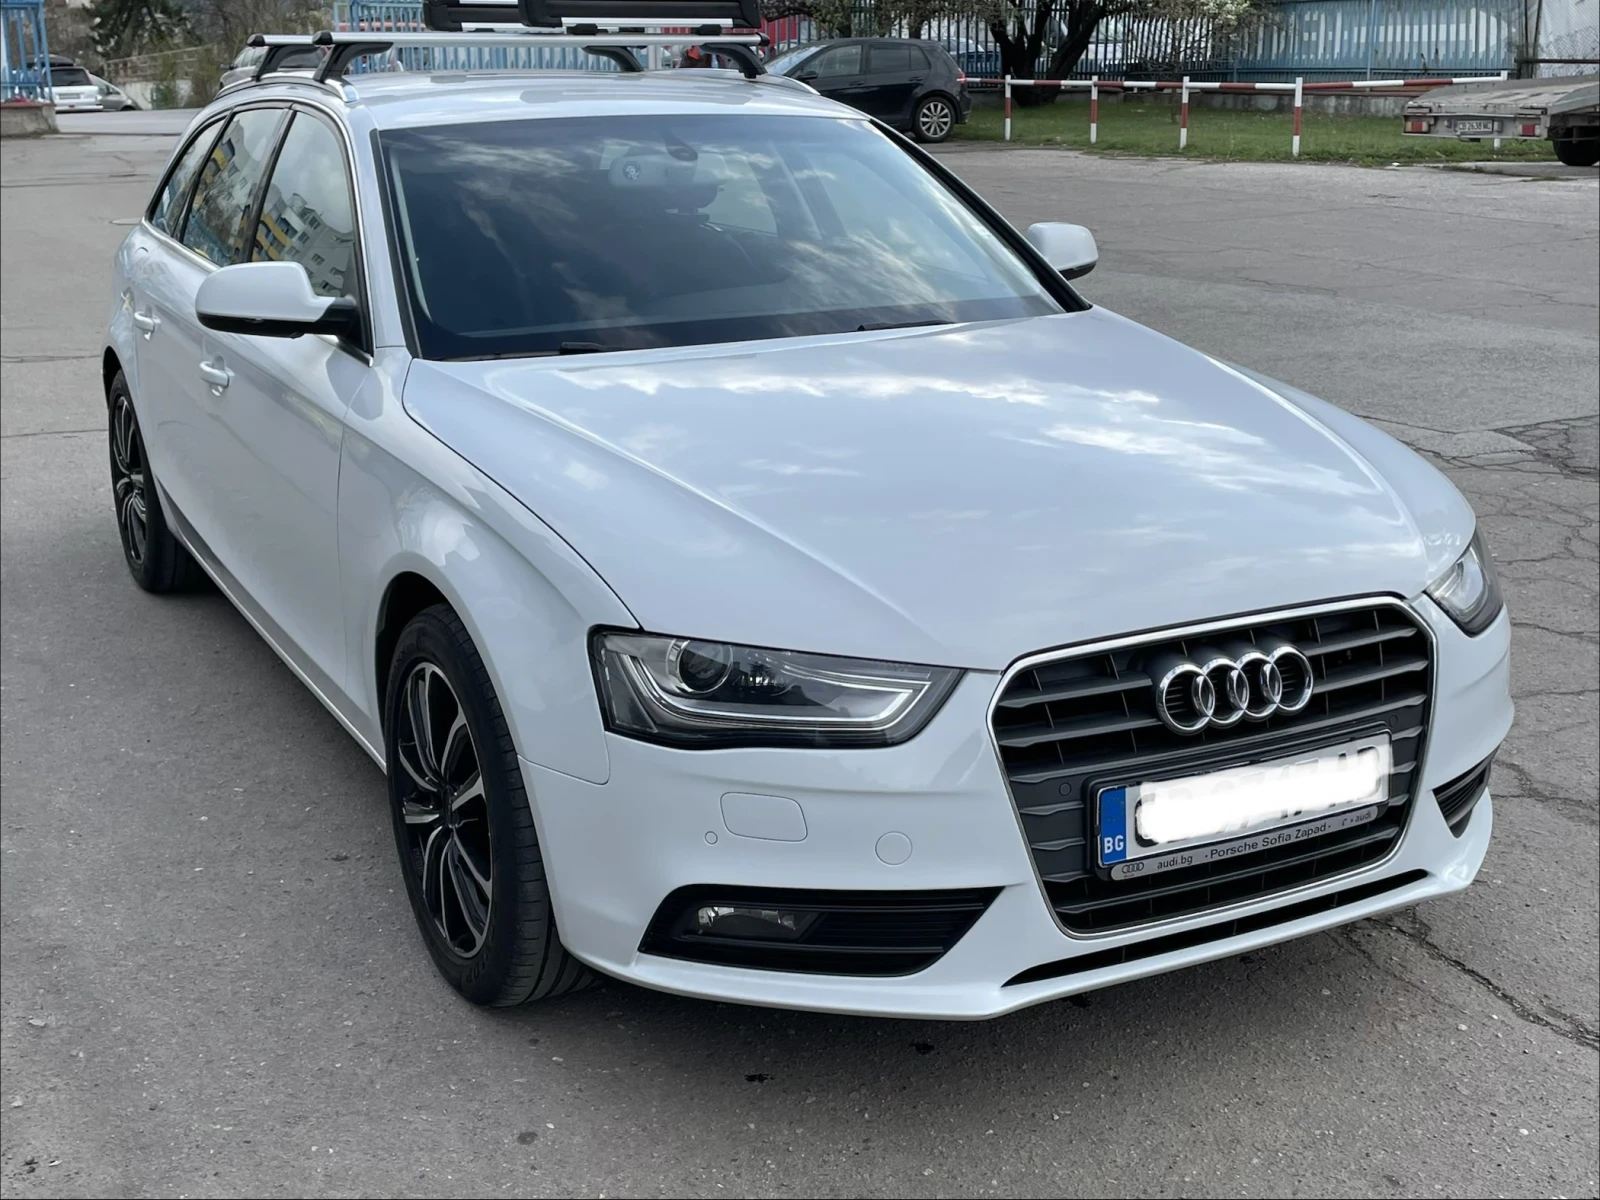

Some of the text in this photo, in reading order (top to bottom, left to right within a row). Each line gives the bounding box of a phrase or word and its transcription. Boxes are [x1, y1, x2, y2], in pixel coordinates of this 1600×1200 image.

[1104, 834, 1125, 854] BG
[1157, 854, 1193, 870] audi.bg
[1210, 841, 1258, 859] Porsche
[1262, 834, 1291, 848] Sofia
[1295, 823, 1327, 840] Zapad
